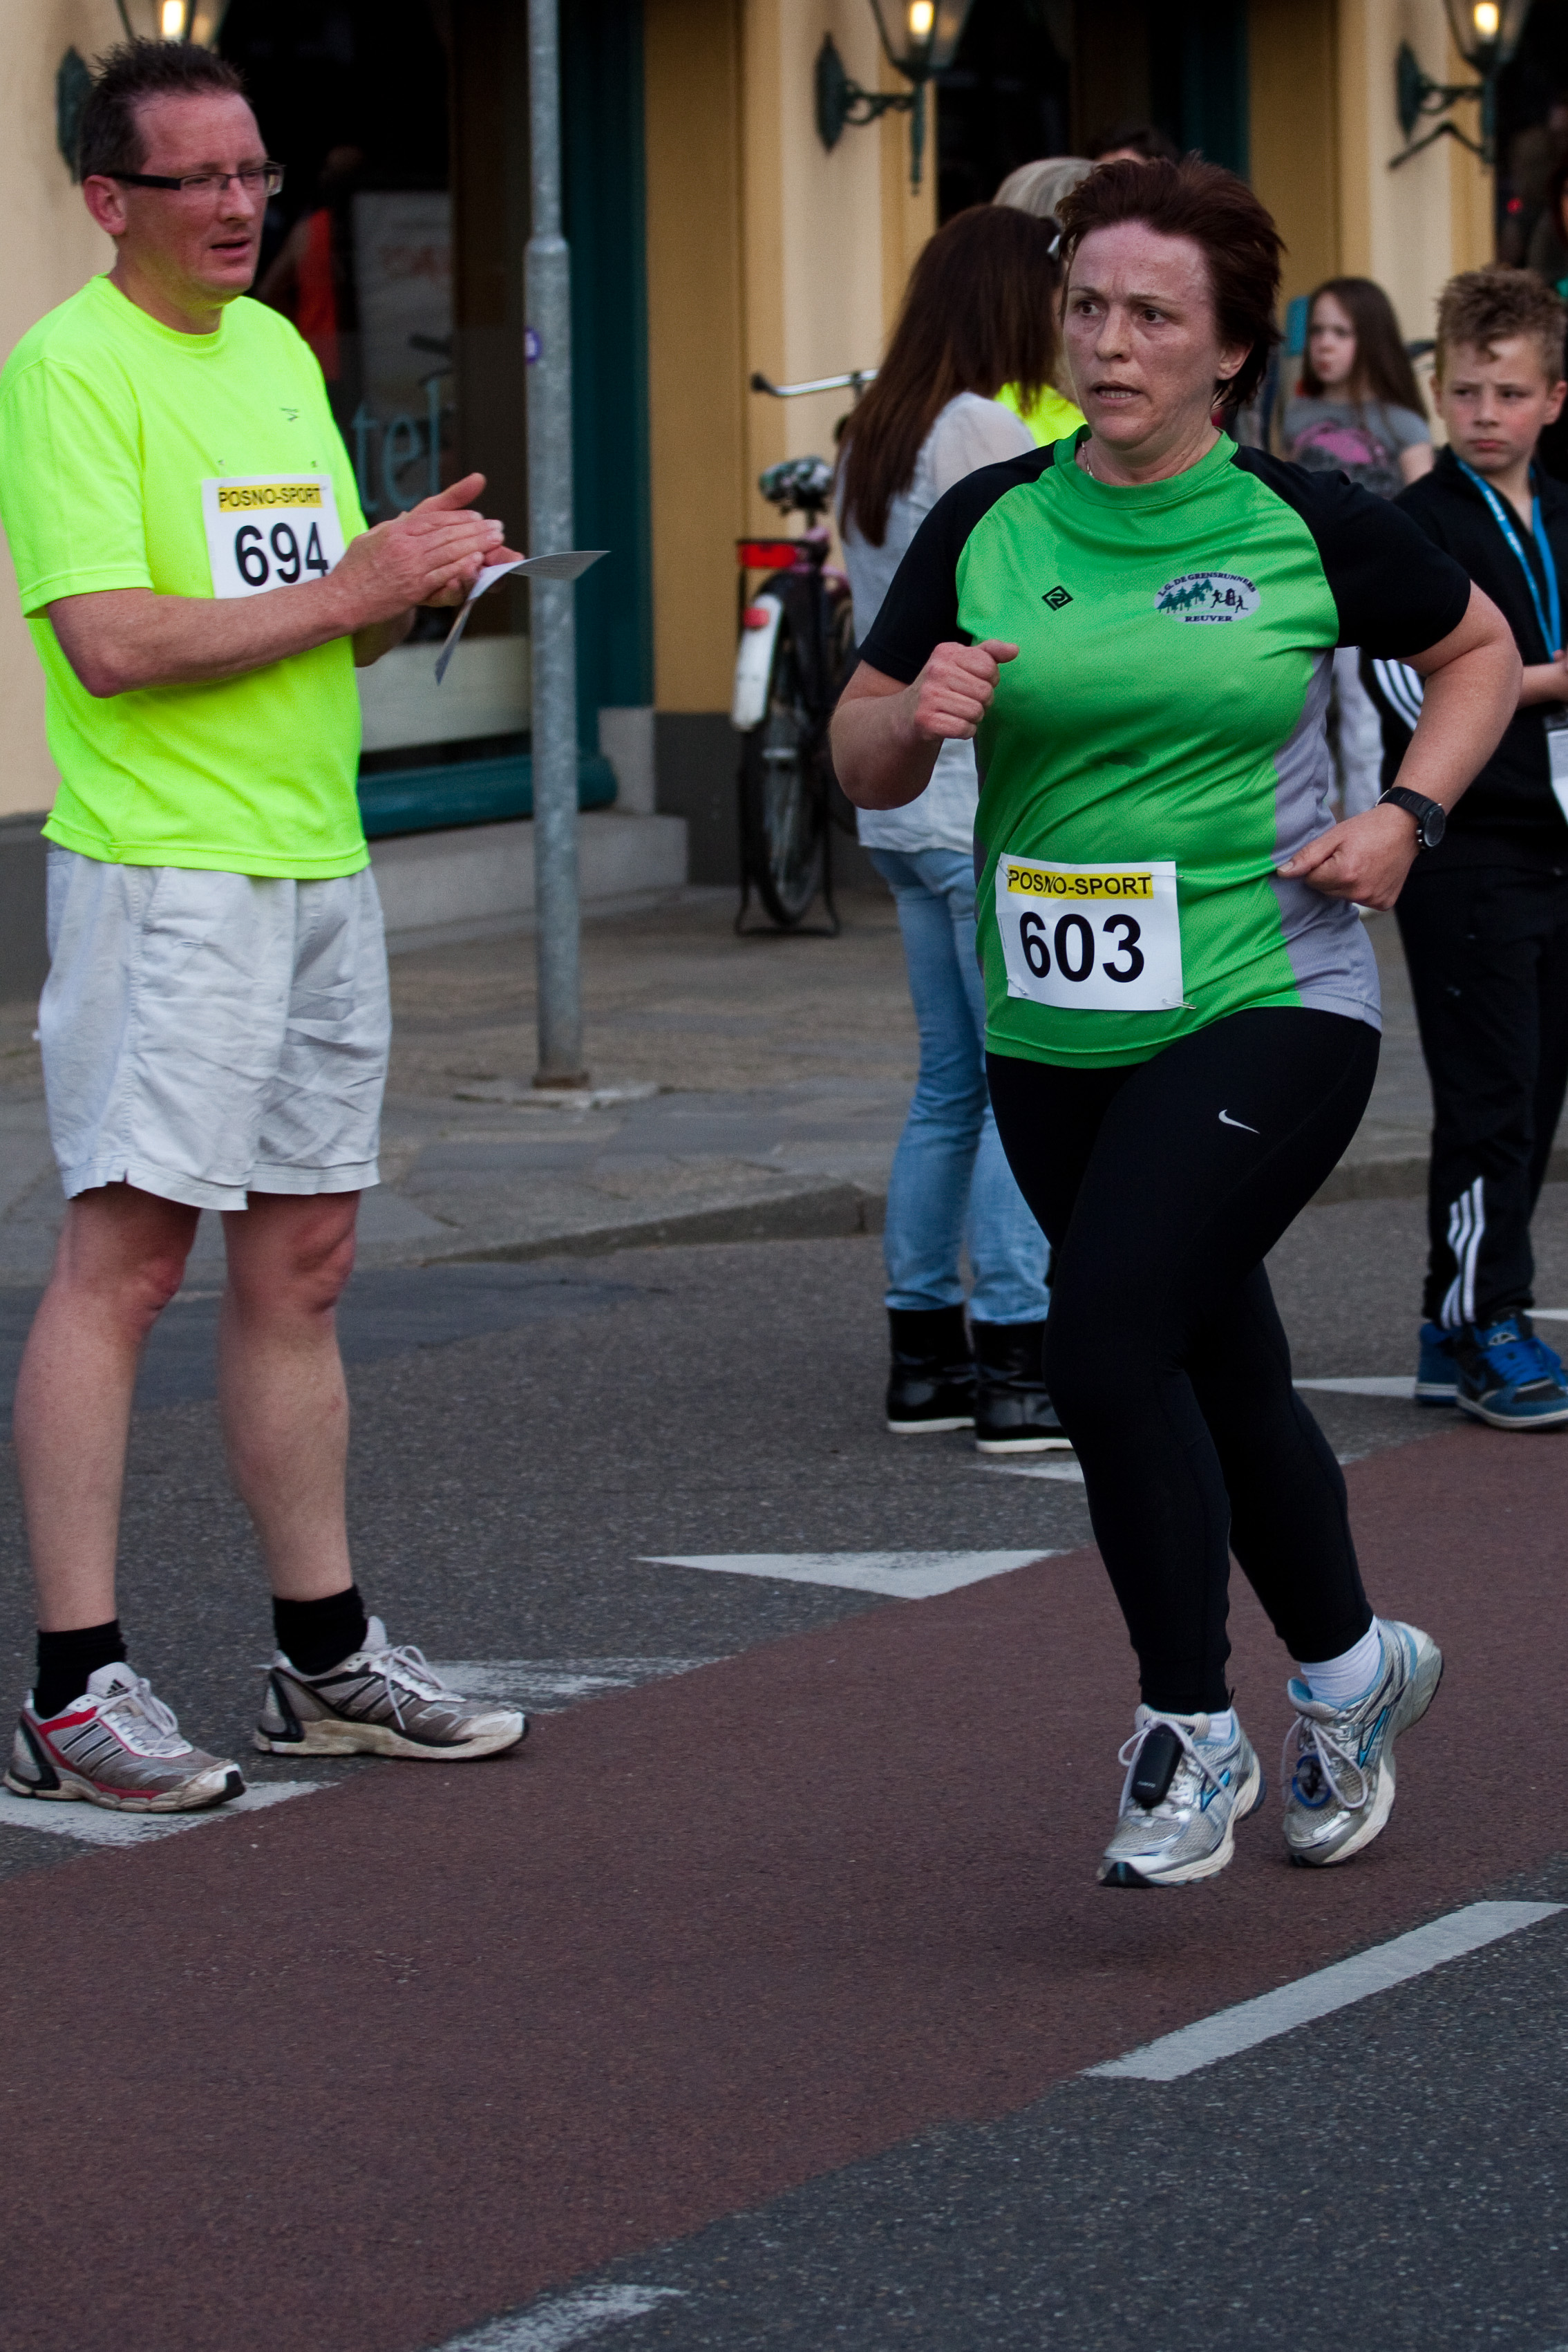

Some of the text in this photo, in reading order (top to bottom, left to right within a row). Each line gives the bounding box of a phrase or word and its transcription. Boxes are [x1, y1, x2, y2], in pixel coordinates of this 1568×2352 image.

[218, 487, 321, 508] POSNO-SPORT
[235, 522, 329, 587] 694
[1174, 576, 1187, 585] DE
[1187, 572, 1256, 592] GRENSRUNNERS
[1008, 869, 1151, 895] POSNO-SPORT
[1019, 911, 1144, 983] 603
